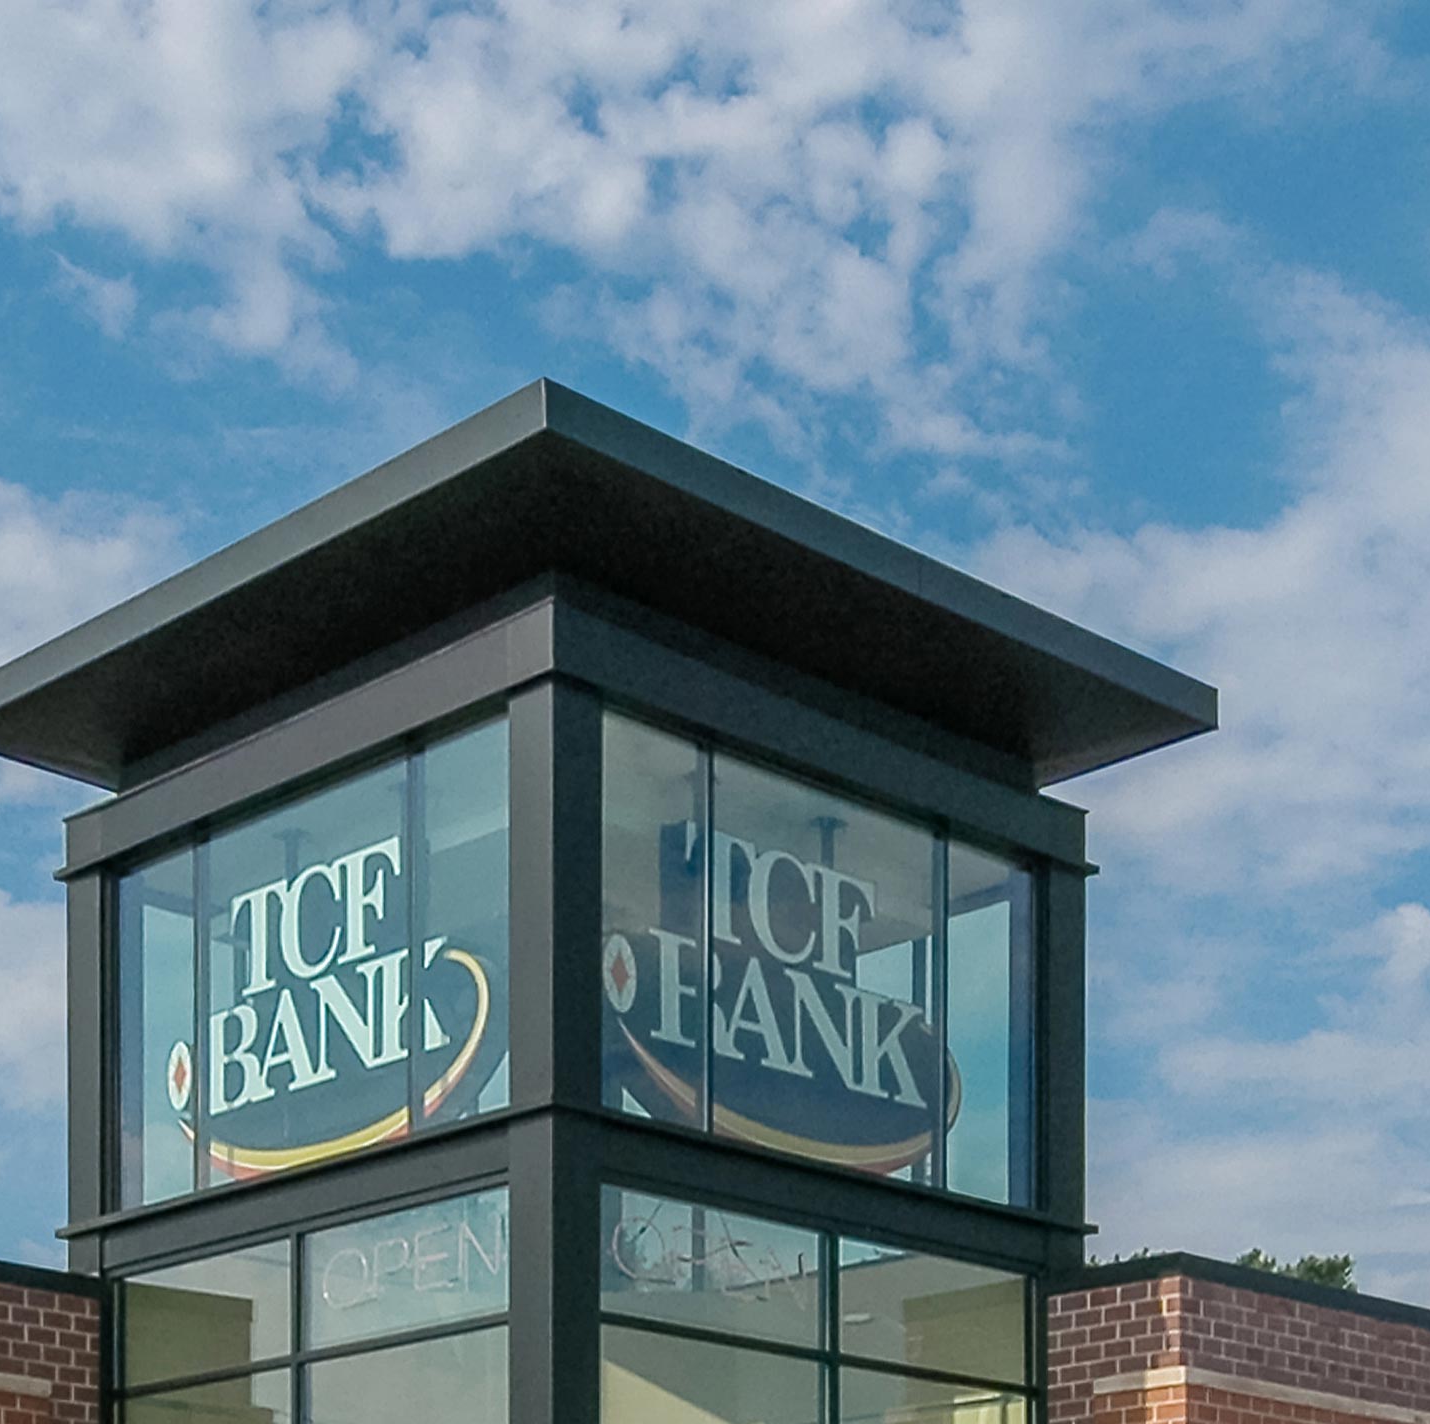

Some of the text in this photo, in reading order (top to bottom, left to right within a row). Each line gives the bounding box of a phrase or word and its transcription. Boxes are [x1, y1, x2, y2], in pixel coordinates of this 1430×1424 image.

[230, 836, 401, 996] TCF
[684, 819, 876, 979] TCF
[210, 936, 451, 1116] BANK
[648, 927, 928, 1110] BANK
[323, 1212, 504, 1310] OPEN
